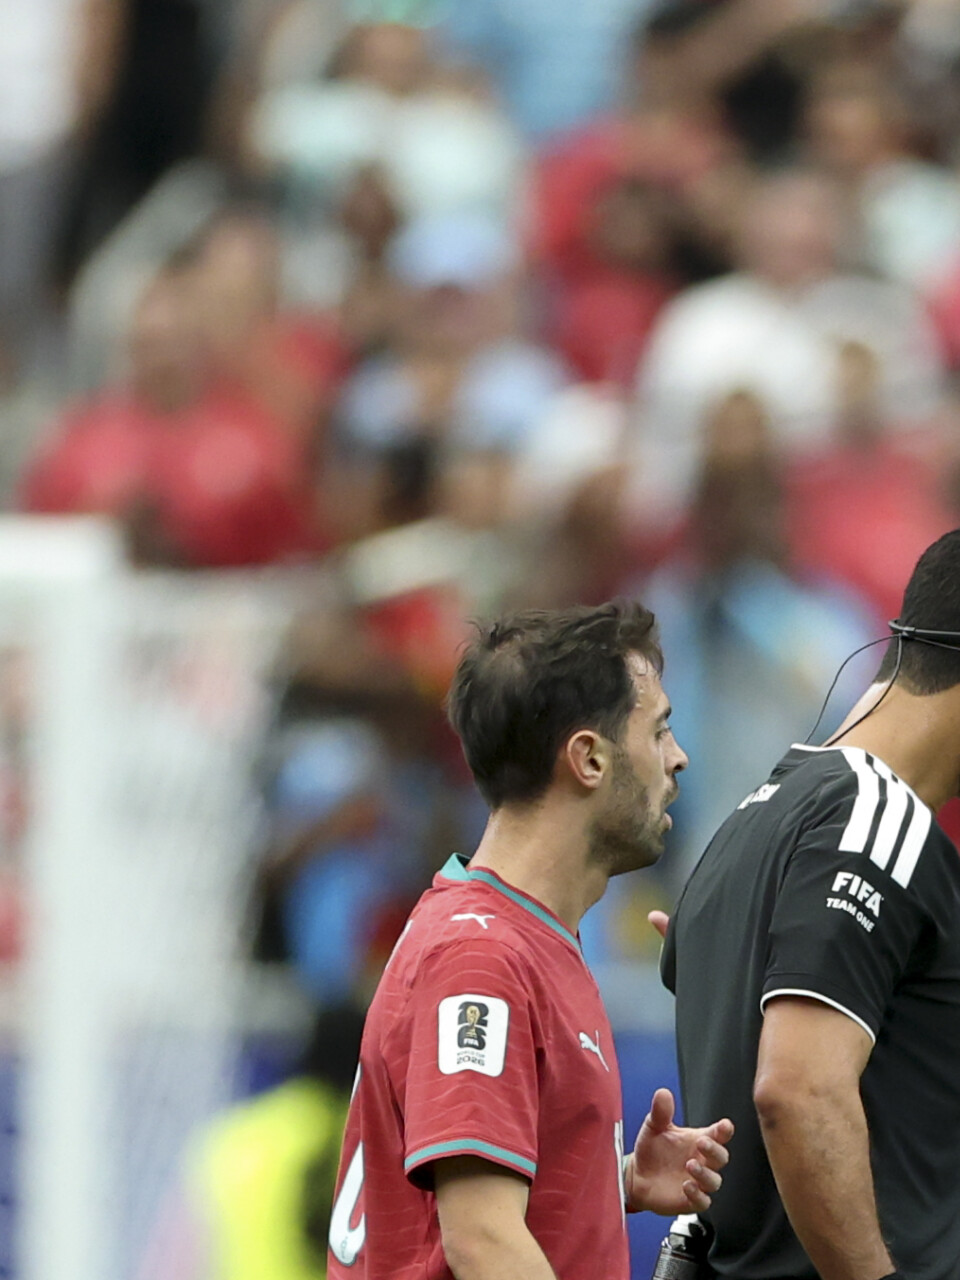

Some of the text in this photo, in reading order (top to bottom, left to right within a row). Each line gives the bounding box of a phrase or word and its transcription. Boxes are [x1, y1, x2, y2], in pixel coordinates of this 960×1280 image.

[826, 897, 876, 933] TEAM ONE
[831, 871, 883, 918] FIFA
